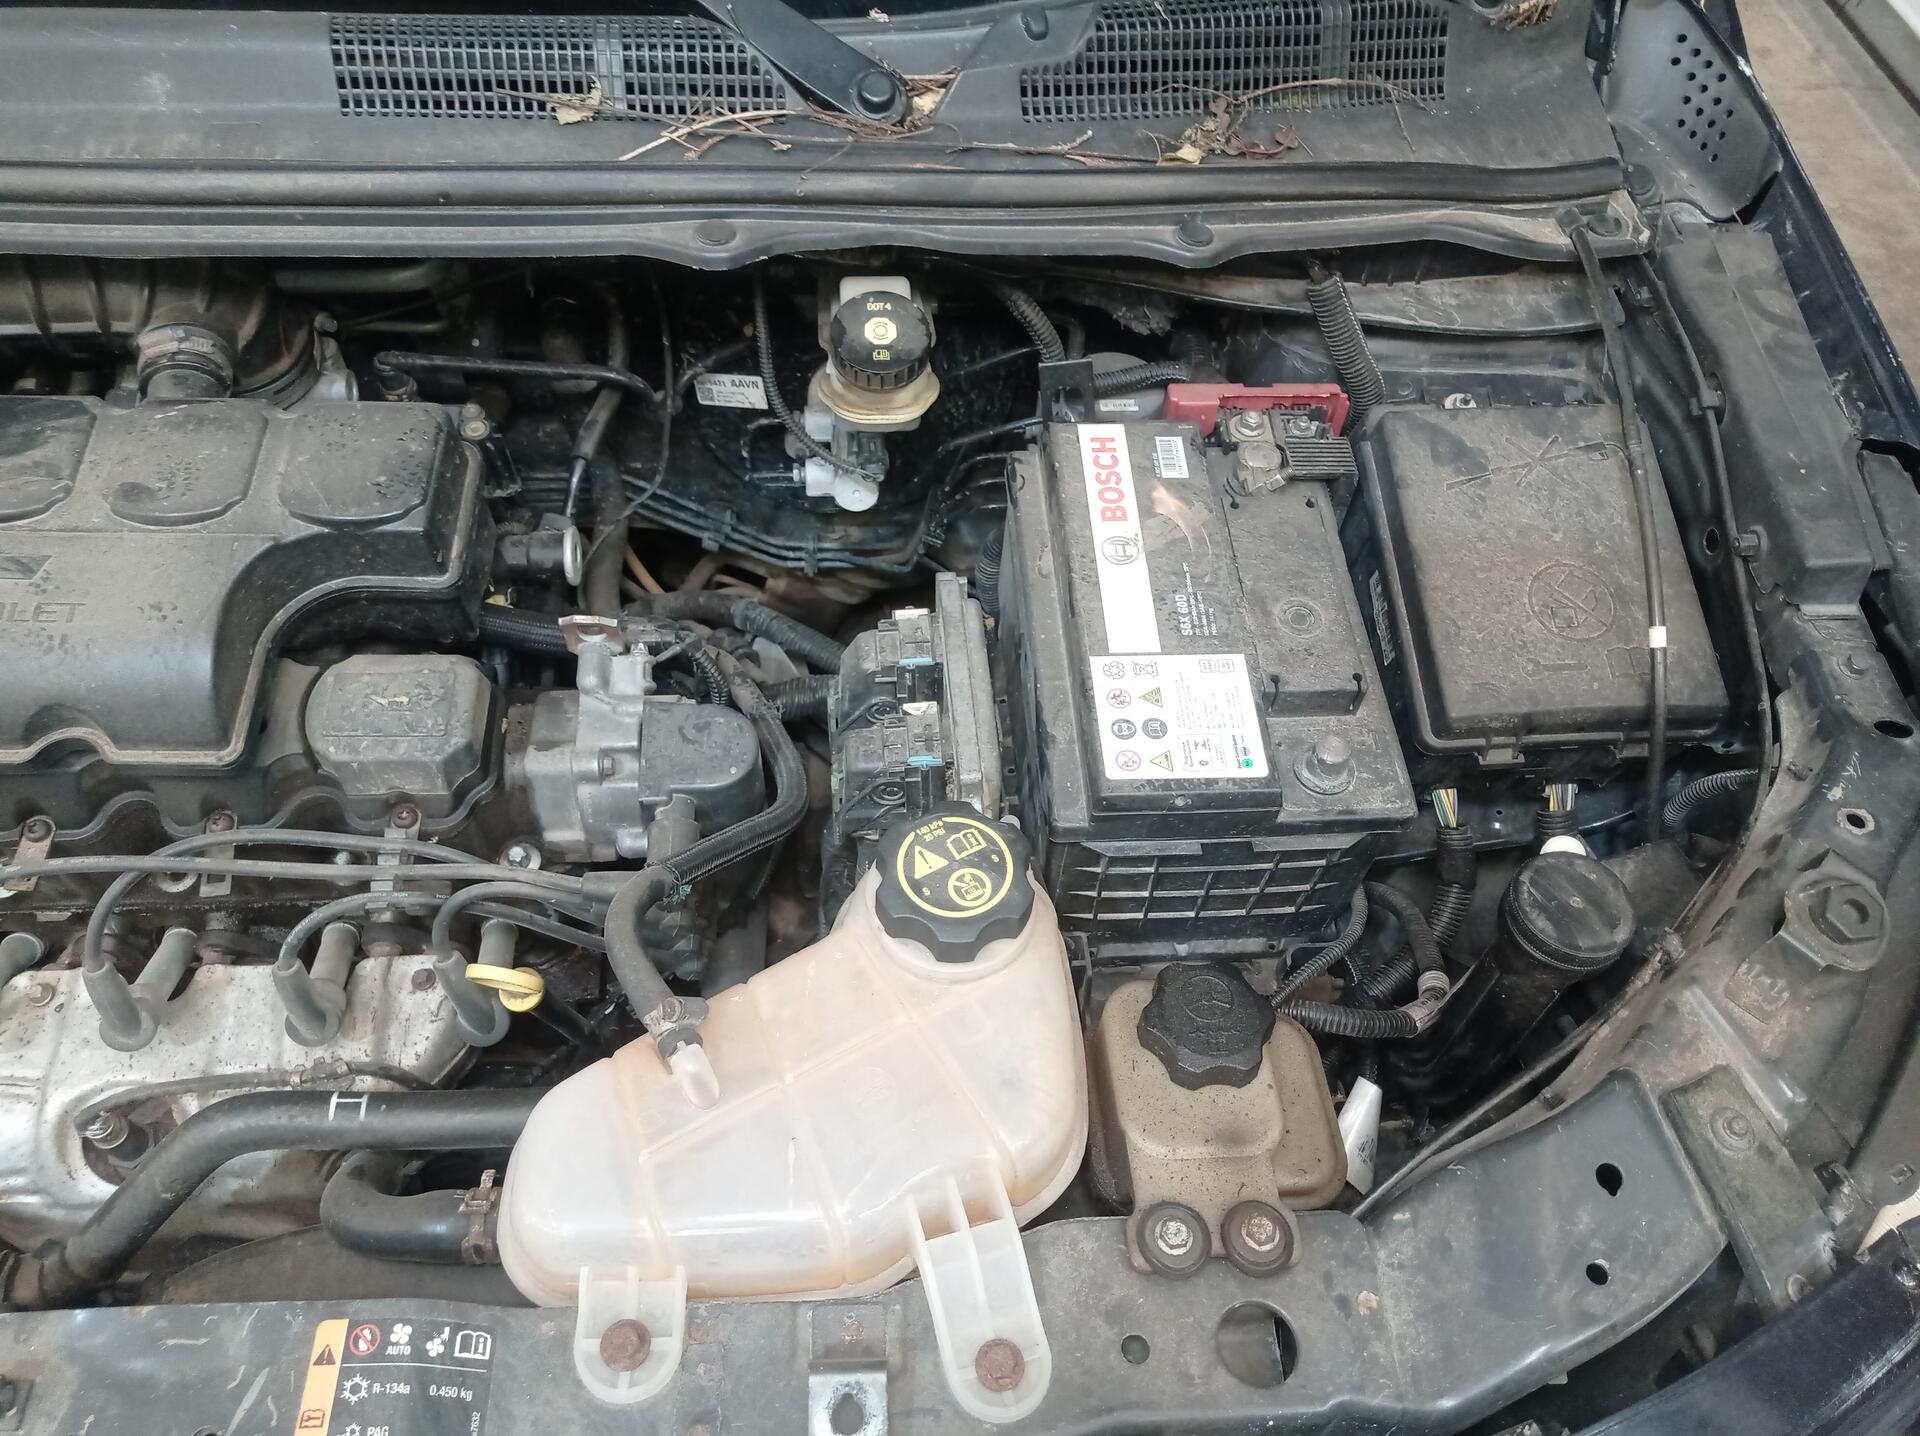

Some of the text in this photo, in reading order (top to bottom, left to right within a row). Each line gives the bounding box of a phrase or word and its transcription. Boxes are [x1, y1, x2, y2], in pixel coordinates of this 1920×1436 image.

[867, 302, 891, 311] DOT 4
[1090, 437, 1128, 522] BOSCH
[0, 602, 87, 623] LET
[1175, 594, 1189, 614] 60D
[1179, 616, 1193, 636] S6X
[923, 827, 946, 842] 20 PSI
[385, 1345, 411, 1355] AUTO
[372, 1382, 473, 1402] R-134a 0.450 kg
[366, 1425, 389, 1436] PAG
